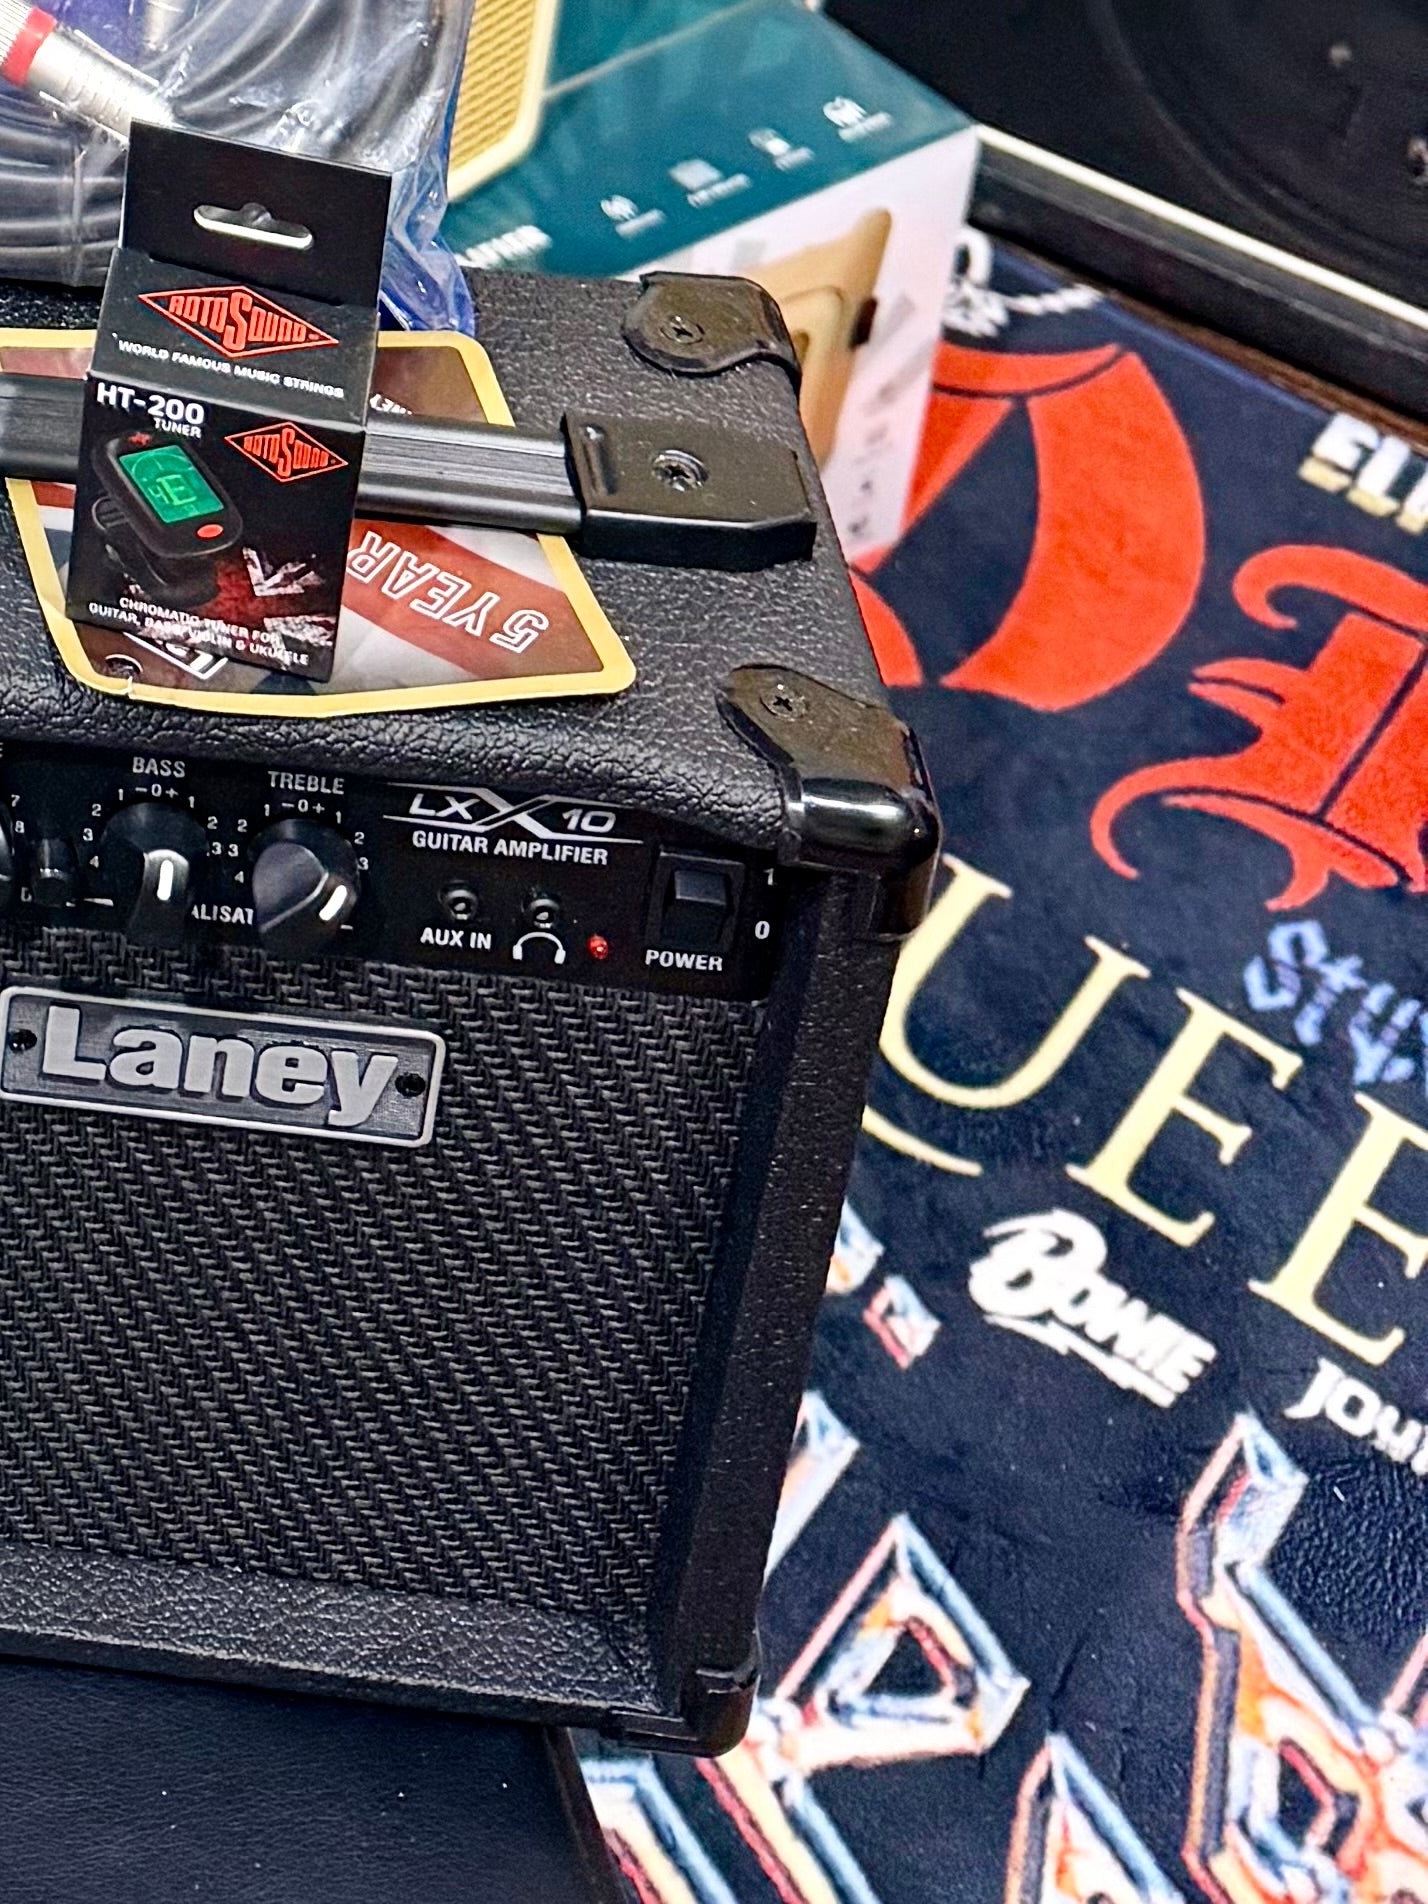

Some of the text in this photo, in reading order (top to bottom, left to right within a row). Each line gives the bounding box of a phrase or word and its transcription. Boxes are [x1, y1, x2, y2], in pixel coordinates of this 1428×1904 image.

[168, 291, 308, 351] ROTOSOUND
[118, 340, 345, 400] WORLD FAMOUS MUSIC STRINGS
[96, 381, 206, 426] HT-200
[153, 418, 204, 440] TUNER
[347, 529, 551, 656] 5 YEAR
[88, 601, 141, 627] GUITAR,
[119, 596, 281, 647] CHROMATIC TUNER FOR
[132, 756, 186, 779] BASS
[267, 770, 346, 796] TREBLE
[11, 793, 22, 808] 7
[14, 820, 25, 834] 8
[82, 827, 94, 842] 3
[91, 803, 102, 818] 2
[206, 815, 219, 830] 2
[236, 818, 249, 834] 2
[227, 842, 240, 858] 3
[353, 831, 366, 845] 2
[411, 829, 609, 867] GUITAR AMPLIFIER
[358, 857, 370, 872] 3
[420, 926, 493, 951] AUX IN
[645, 948, 724, 973] POWER
[42, 1003, 400, 1129] Laney
[967, 1207, 1218, 1410] BOWIE
